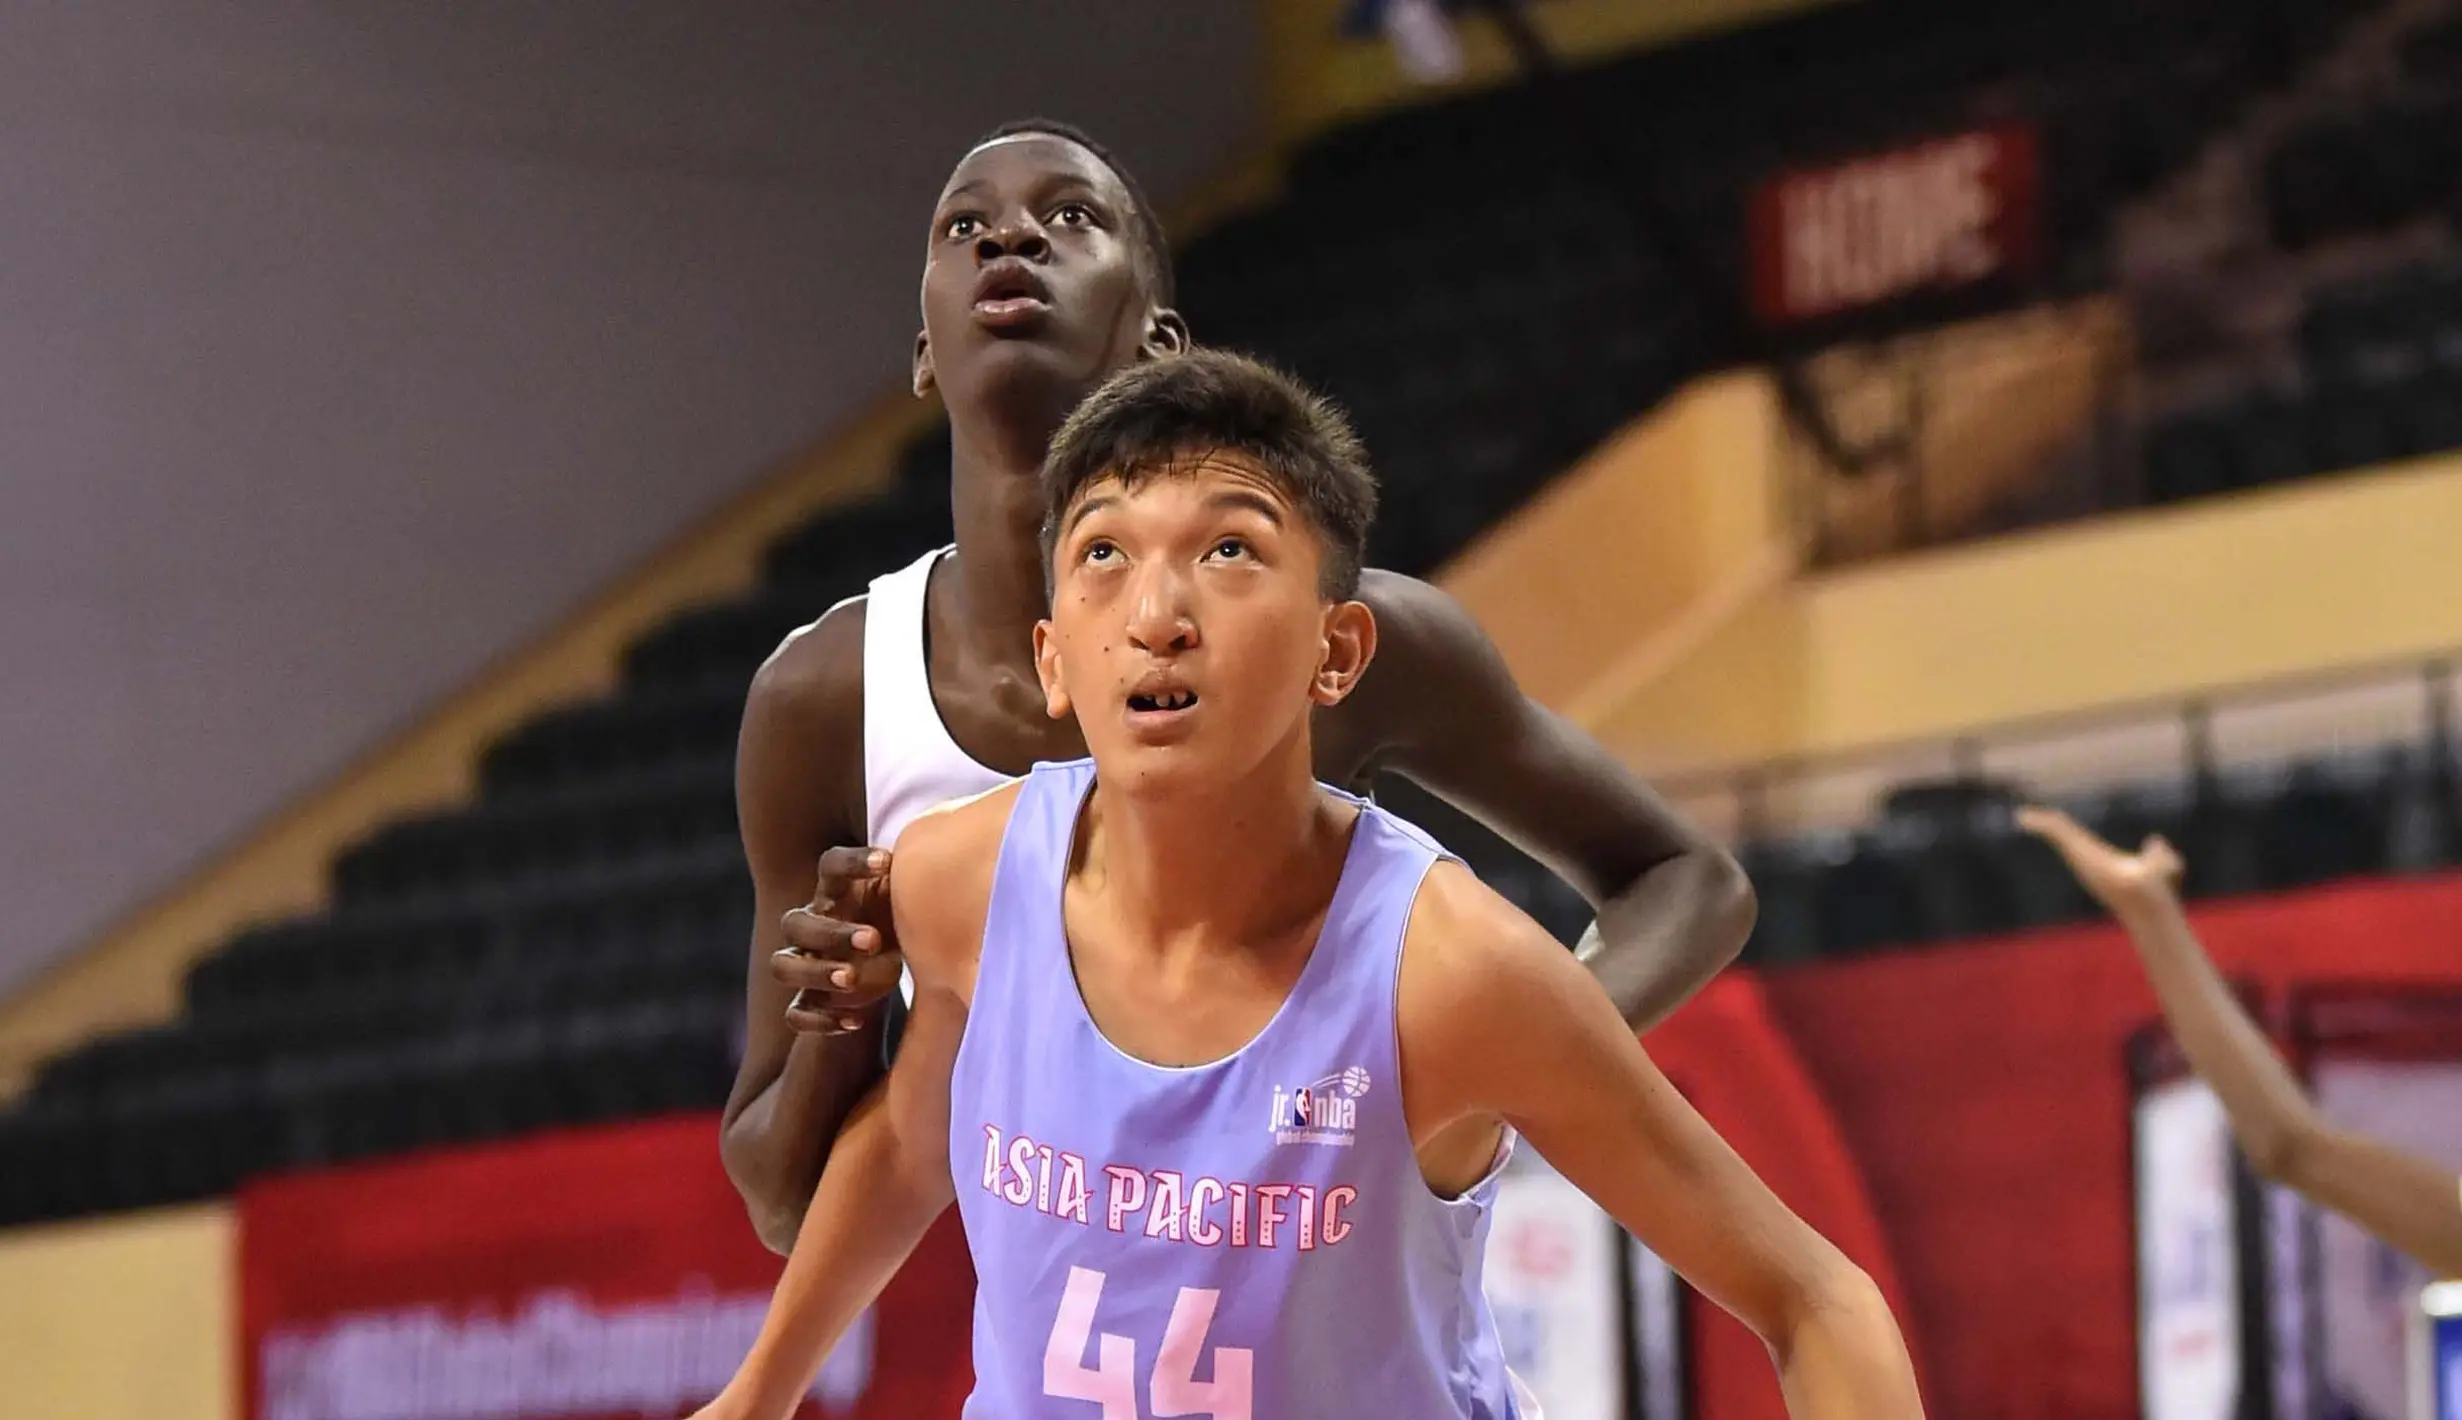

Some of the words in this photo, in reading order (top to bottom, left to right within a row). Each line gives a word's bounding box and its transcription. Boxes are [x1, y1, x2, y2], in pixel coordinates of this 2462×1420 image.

[1268, 1084, 1291, 1133] jr.
[1314, 1090, 1356, 1129] nba
[981, 1123, 1094, 1225] ASIA
[1103, 1165, 1358, 1251] PACIFIC
[1043, 1266, 1254, 1420] 44
